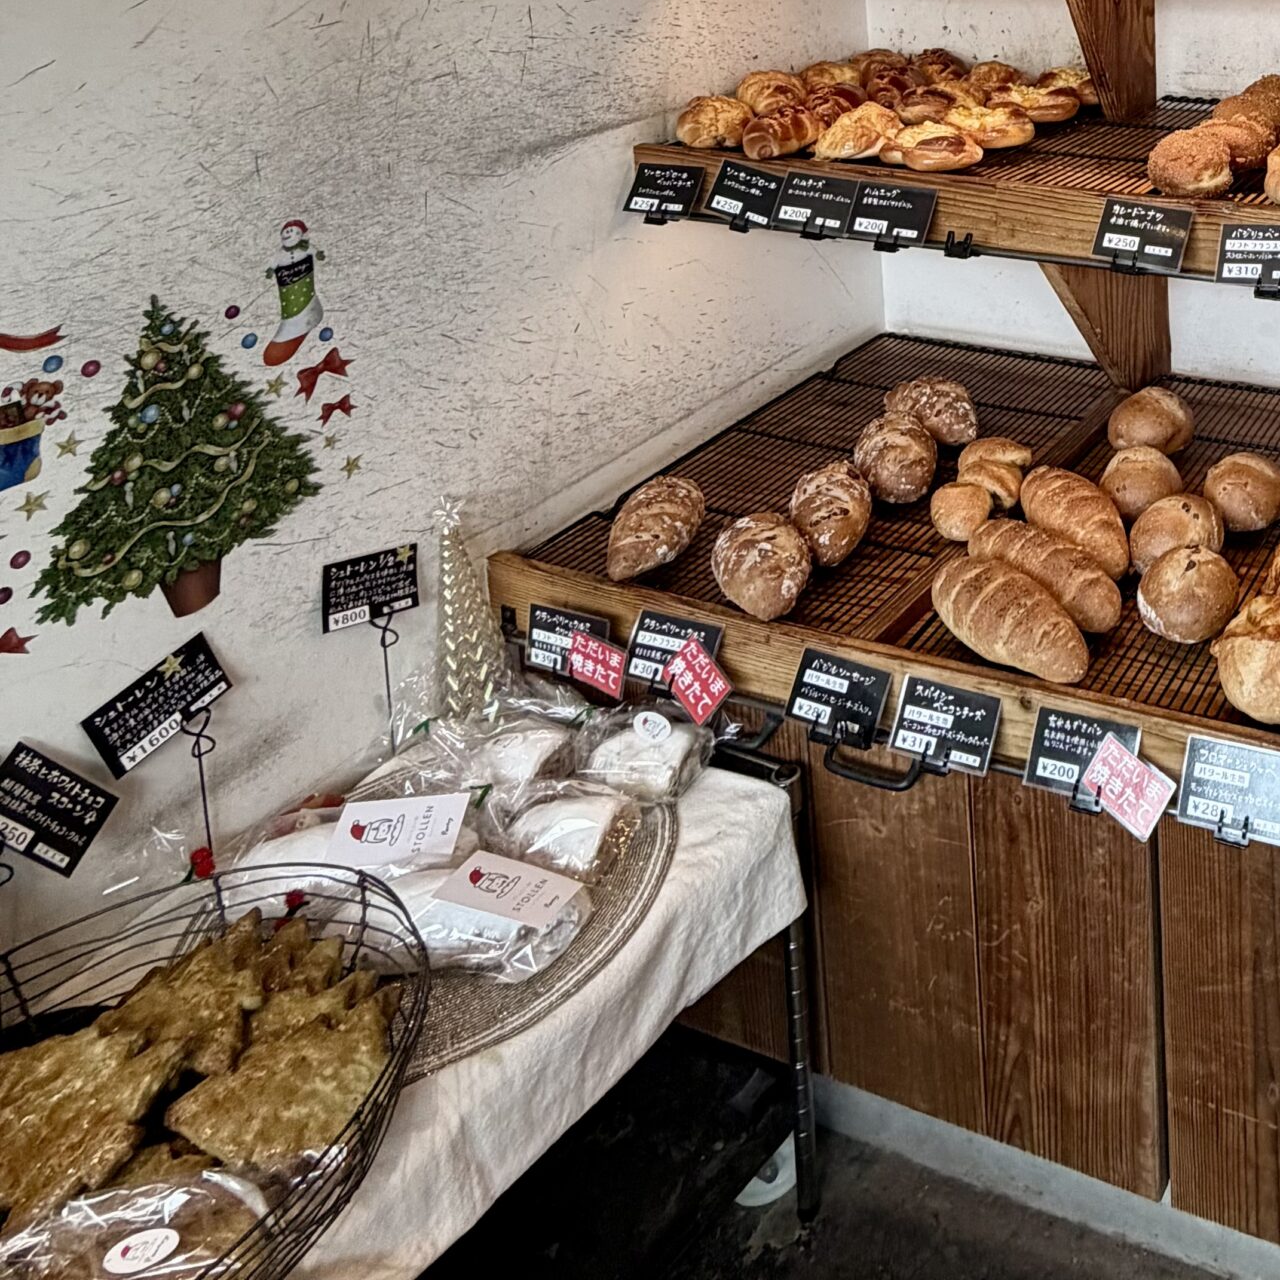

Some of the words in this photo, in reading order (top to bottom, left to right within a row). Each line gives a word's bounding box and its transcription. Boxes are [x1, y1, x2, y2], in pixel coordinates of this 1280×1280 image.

[715, 198, 740, 212] ¥250
[782, 208, 808, 220] ¥200
[857, 220, 884, 231] ¥200
[1107, 235, 1136, 249] ¥250
[1227, 265, 1259, 276] ¥310
[333, 608, 367, 627] ¥800
[574, 634, 622, 668] ただいま
[571, 652, 619, 690] 焼きたて
[683, 642, 726, 696] ただいま
[811, 658, 876, 686] バジルソーセージ
[667, 656, 713, 715] 焼きたて
[914, 684, 955, 702] スパイシー
[94, 676, 159, 728] シュトーレン
[798, 701, 828, 721] ¥280
[125, 717, 181, 764] ¥1600
[1040, 761, 1075, 780] ¥200
[1103, 743, 1164, 801] ただいま
[1089, 761, 1153, 825] 焼きたて
[411, 805, 435, 854] STOLLEN
[512, 878, 549, 913] STOLLEN
